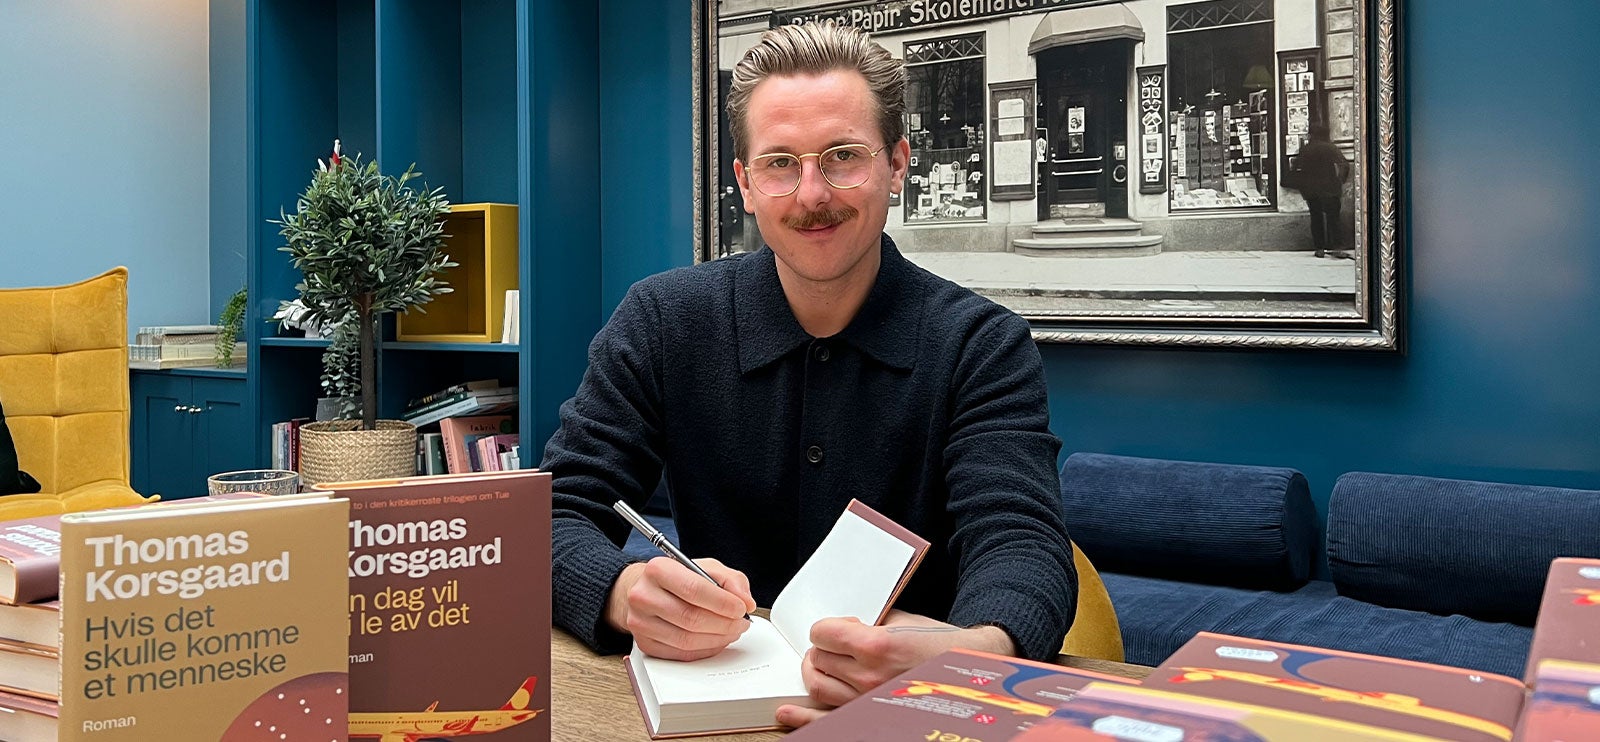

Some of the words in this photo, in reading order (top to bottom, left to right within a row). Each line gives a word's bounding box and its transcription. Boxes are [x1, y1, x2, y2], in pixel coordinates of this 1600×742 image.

[353, 502, 363, 510] to
[369, 500, 387, 509] den
[479, 493, 492, 501] om
[84, 529, 249, 568] Thomas
[348, 517, 467, 548] homas
[86, 551, 290, 603] Korsgaard
[348, 593, 366, 613] n
[373, 586, 425, 612] dag
[431, 579, 458, 604] vil
[86, 612, 155, 642] Hvis
[164, 605, 215, 633] det
[360, 612, 383, 635] le
[390, 612, 422, 633] av
[427, 603, 470, 628] det
[84, 638, 177, 672] skulle
[187, 625, 299, 658] komme
[348, 653, 374, 664] man
[83, 673, 116, 700] et
[127, 652, 287, 695] menneske
[82, 715, 137, 733] Roman
